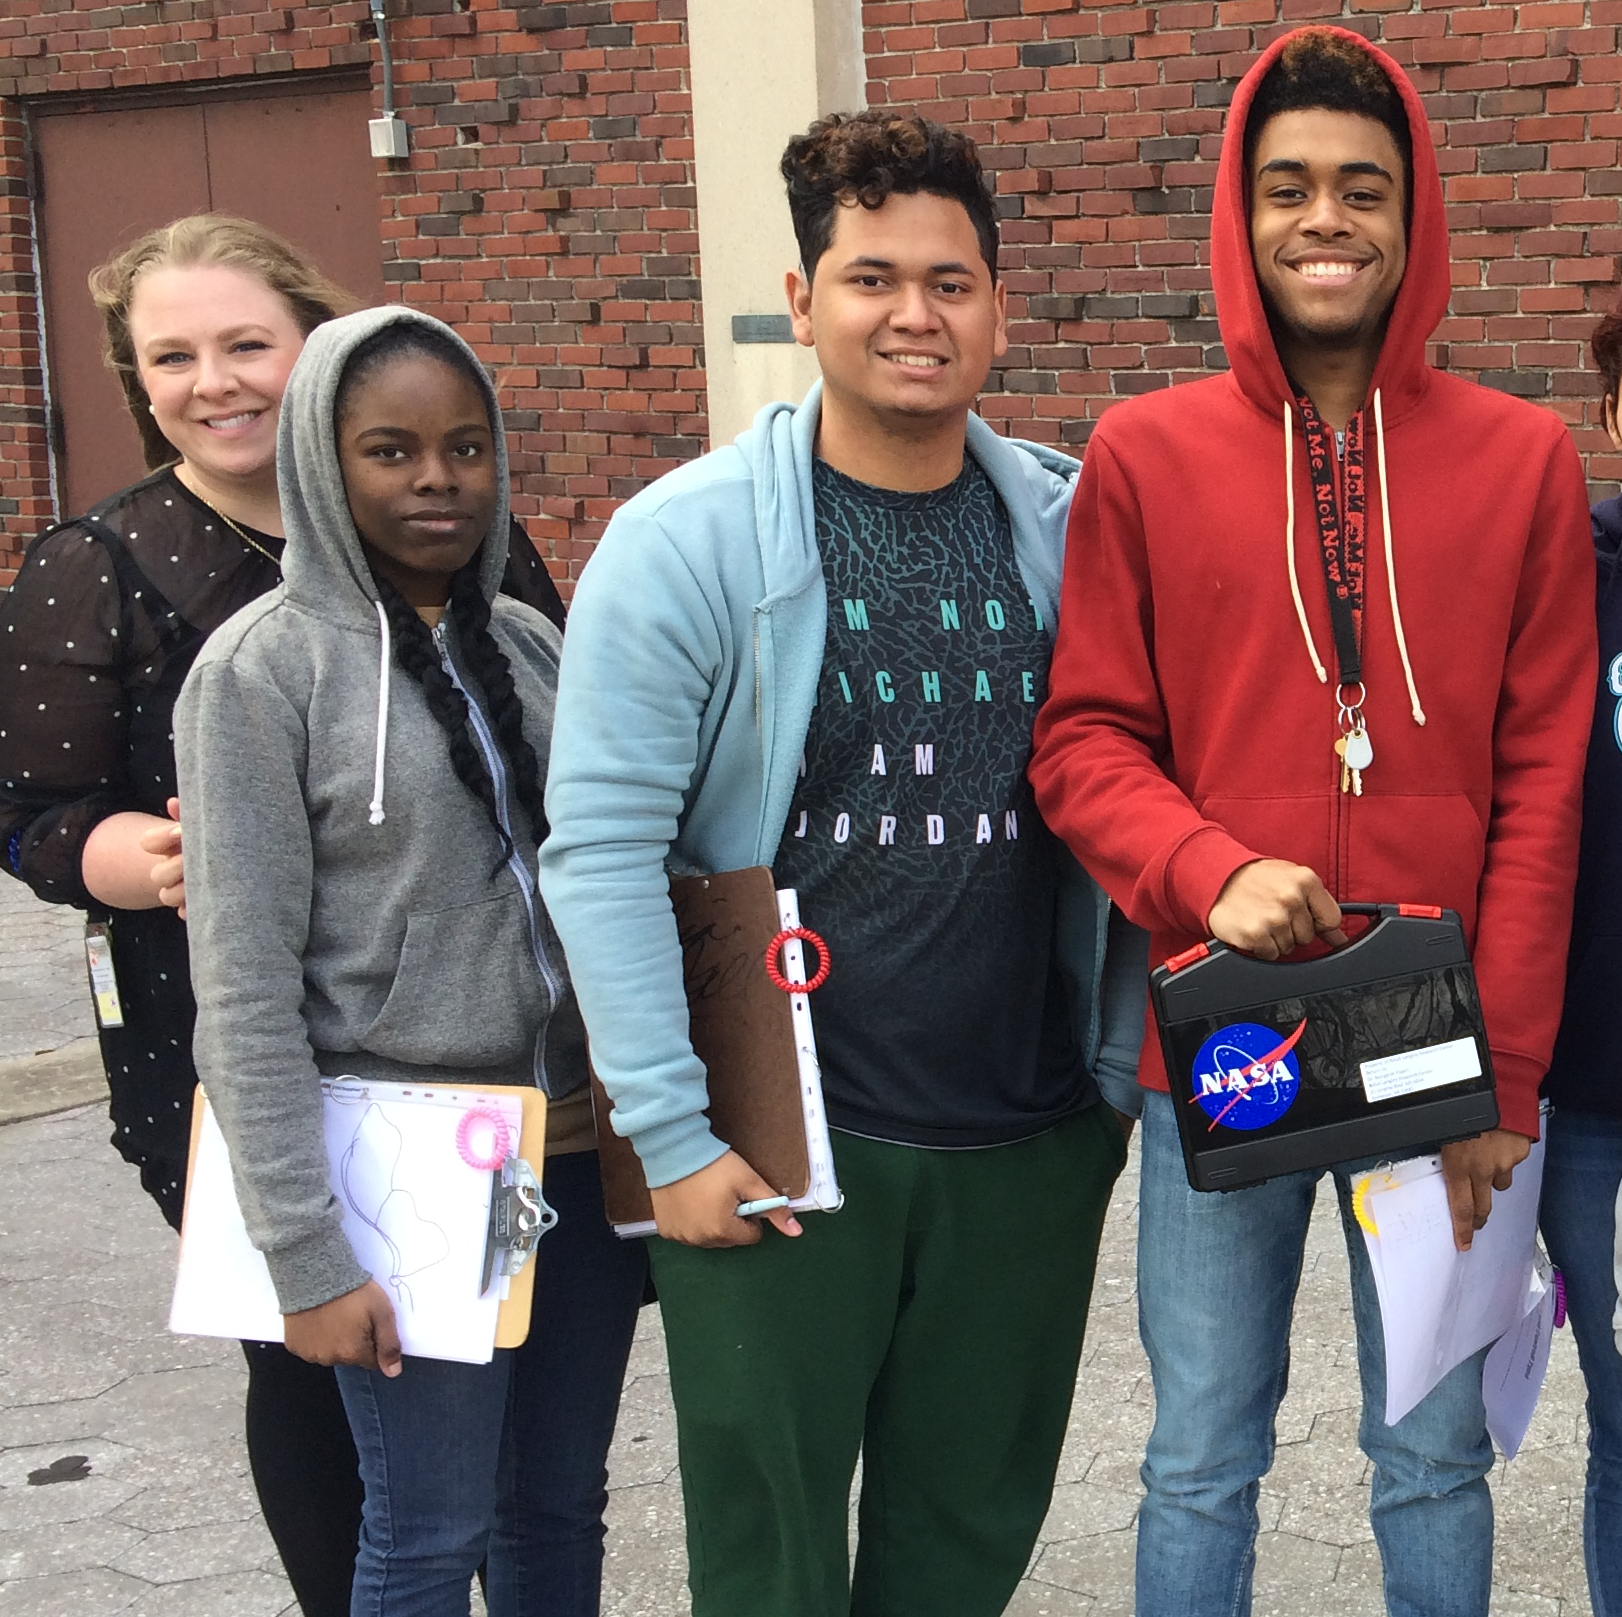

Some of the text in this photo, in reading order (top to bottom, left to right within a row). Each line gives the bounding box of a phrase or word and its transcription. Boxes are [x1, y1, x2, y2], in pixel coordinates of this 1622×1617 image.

[1315, 484, 1335, 526] Not
[939, 598, 1044, 631] NOT
[837, 670, 1036, 704] ICHAE
[870, 743, 934, 776] AM
[794, 809, 1018, 846] JORDAN
[1199, 1060, 1295, 1096] NASA
